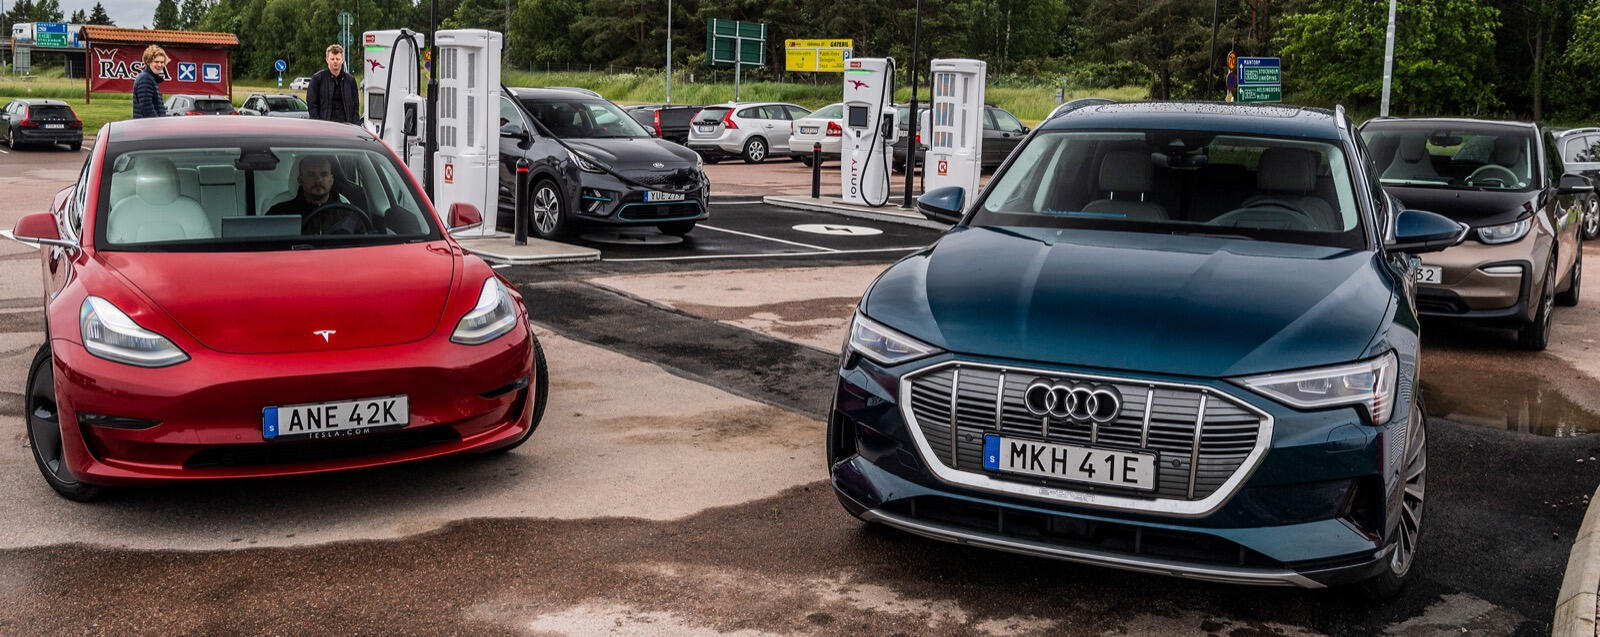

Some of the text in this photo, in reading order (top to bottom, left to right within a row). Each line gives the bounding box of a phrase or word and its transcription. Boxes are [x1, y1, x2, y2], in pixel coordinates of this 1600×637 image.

[289, 400, 398, 431] ANE 42K
[309, 428, 370, 440] TESLA.COM
[1010, 442, 1140, 484] MKH 41E
